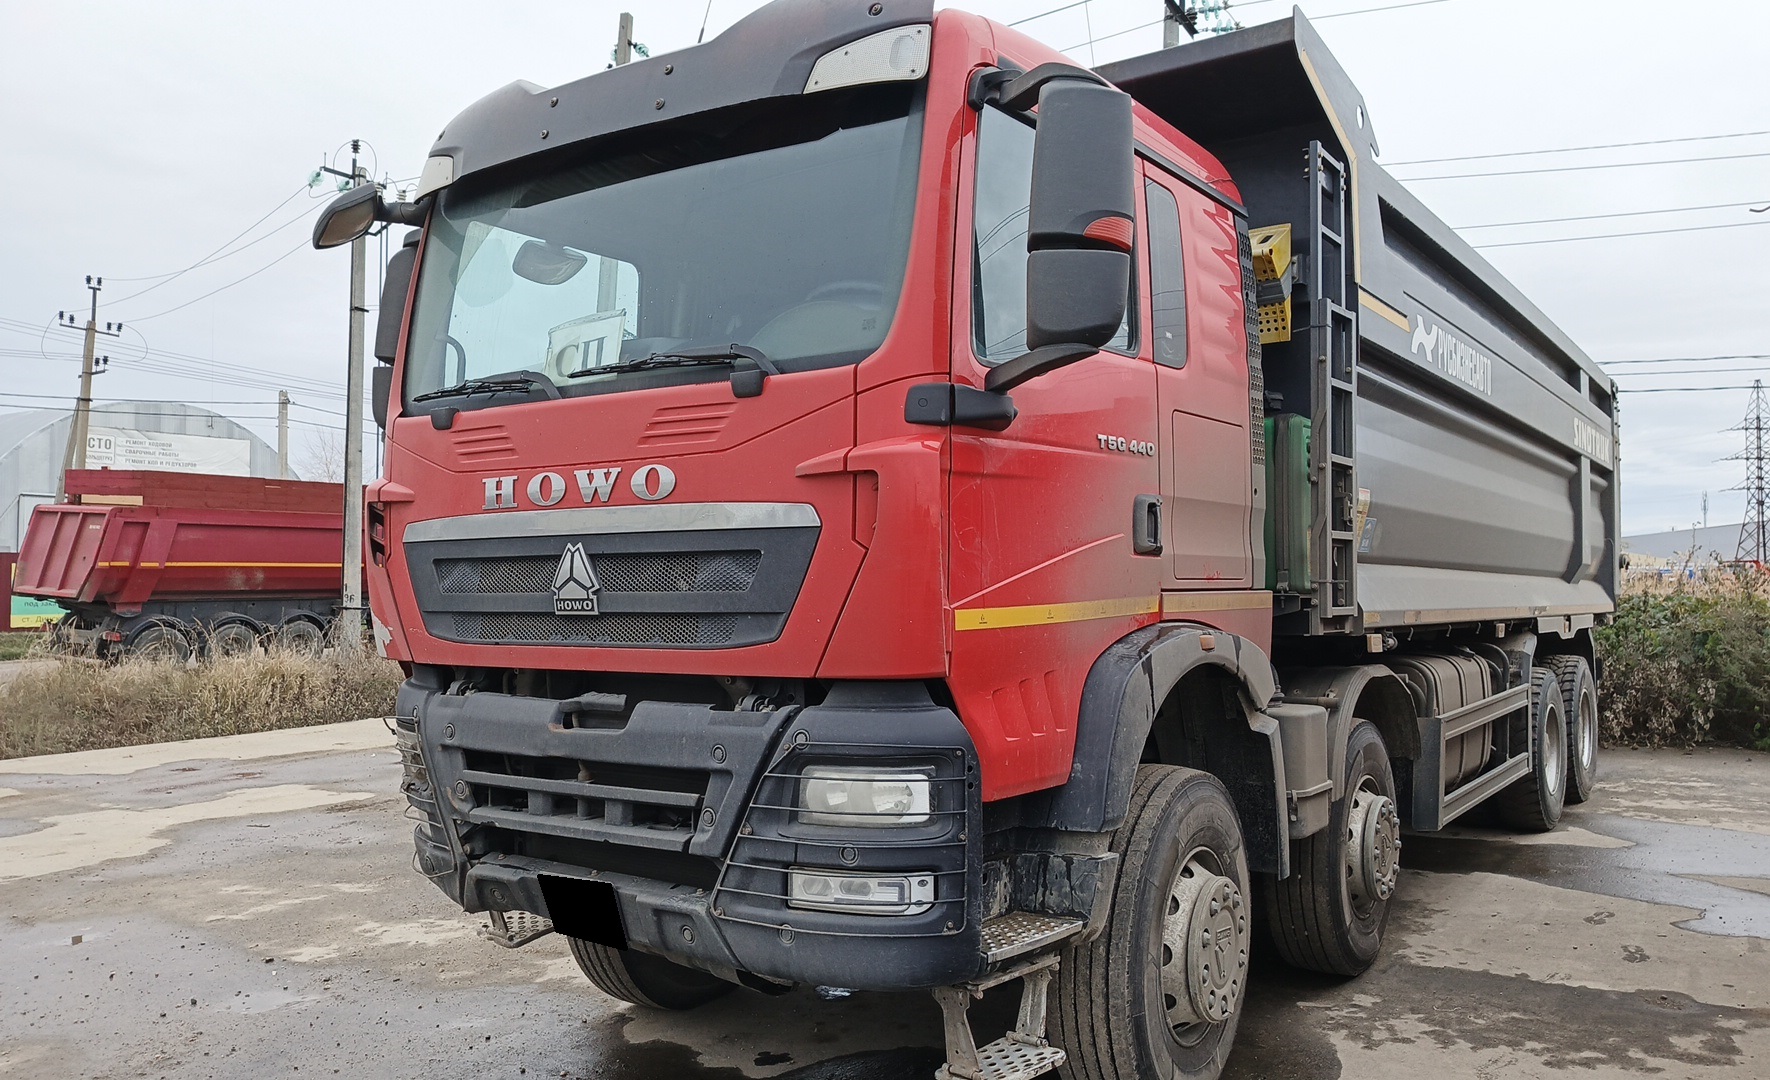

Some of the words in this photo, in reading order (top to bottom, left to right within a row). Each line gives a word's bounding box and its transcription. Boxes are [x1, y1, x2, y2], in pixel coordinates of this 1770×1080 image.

[88, 437, 112, 450] СТО
[1097, 433, 1127, 452] T5G
[1129, 439, 1156, 457] 440
[1573, 417, 1610, 463] SINOTRUK
[124, 448, 157, 457] СВАРОЧНЫЕ
[158, 450, 180, 458] РАБОТЫ
[124, 457, 146, 465] РЕМОНТ
[165, 460, 198, 468] РЕДУКТОРОВ
[482, 464, 676, 510] HOWO
[556, 600, 593, 611] HOWO
